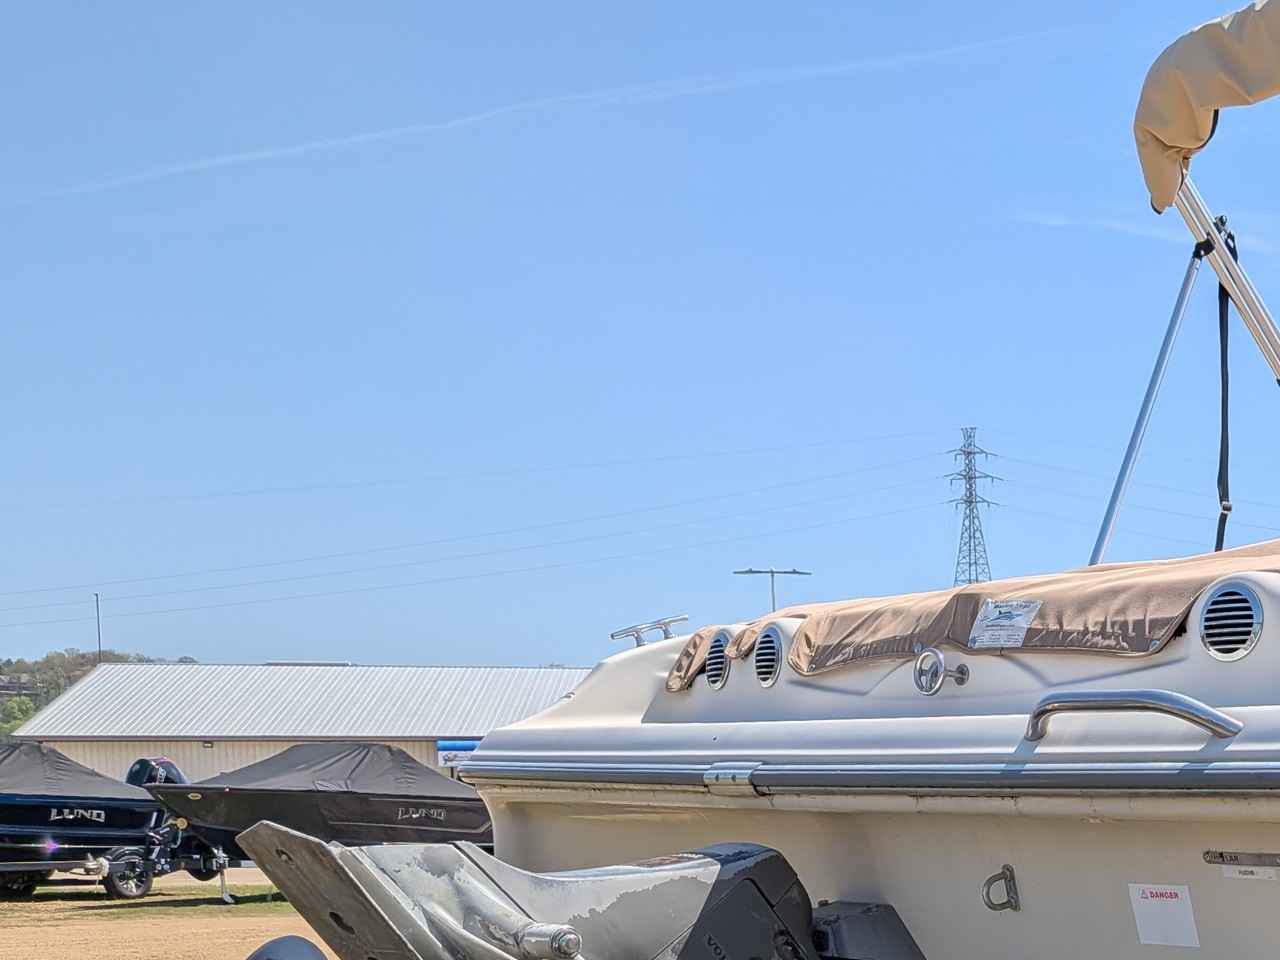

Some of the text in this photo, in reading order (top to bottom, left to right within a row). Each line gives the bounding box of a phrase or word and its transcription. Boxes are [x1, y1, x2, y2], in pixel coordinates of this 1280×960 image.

[49, 808, 105, 822] LUND
[397, 807, 447, 821] LUND
[1149, 890, 1180, 900] DANGER
